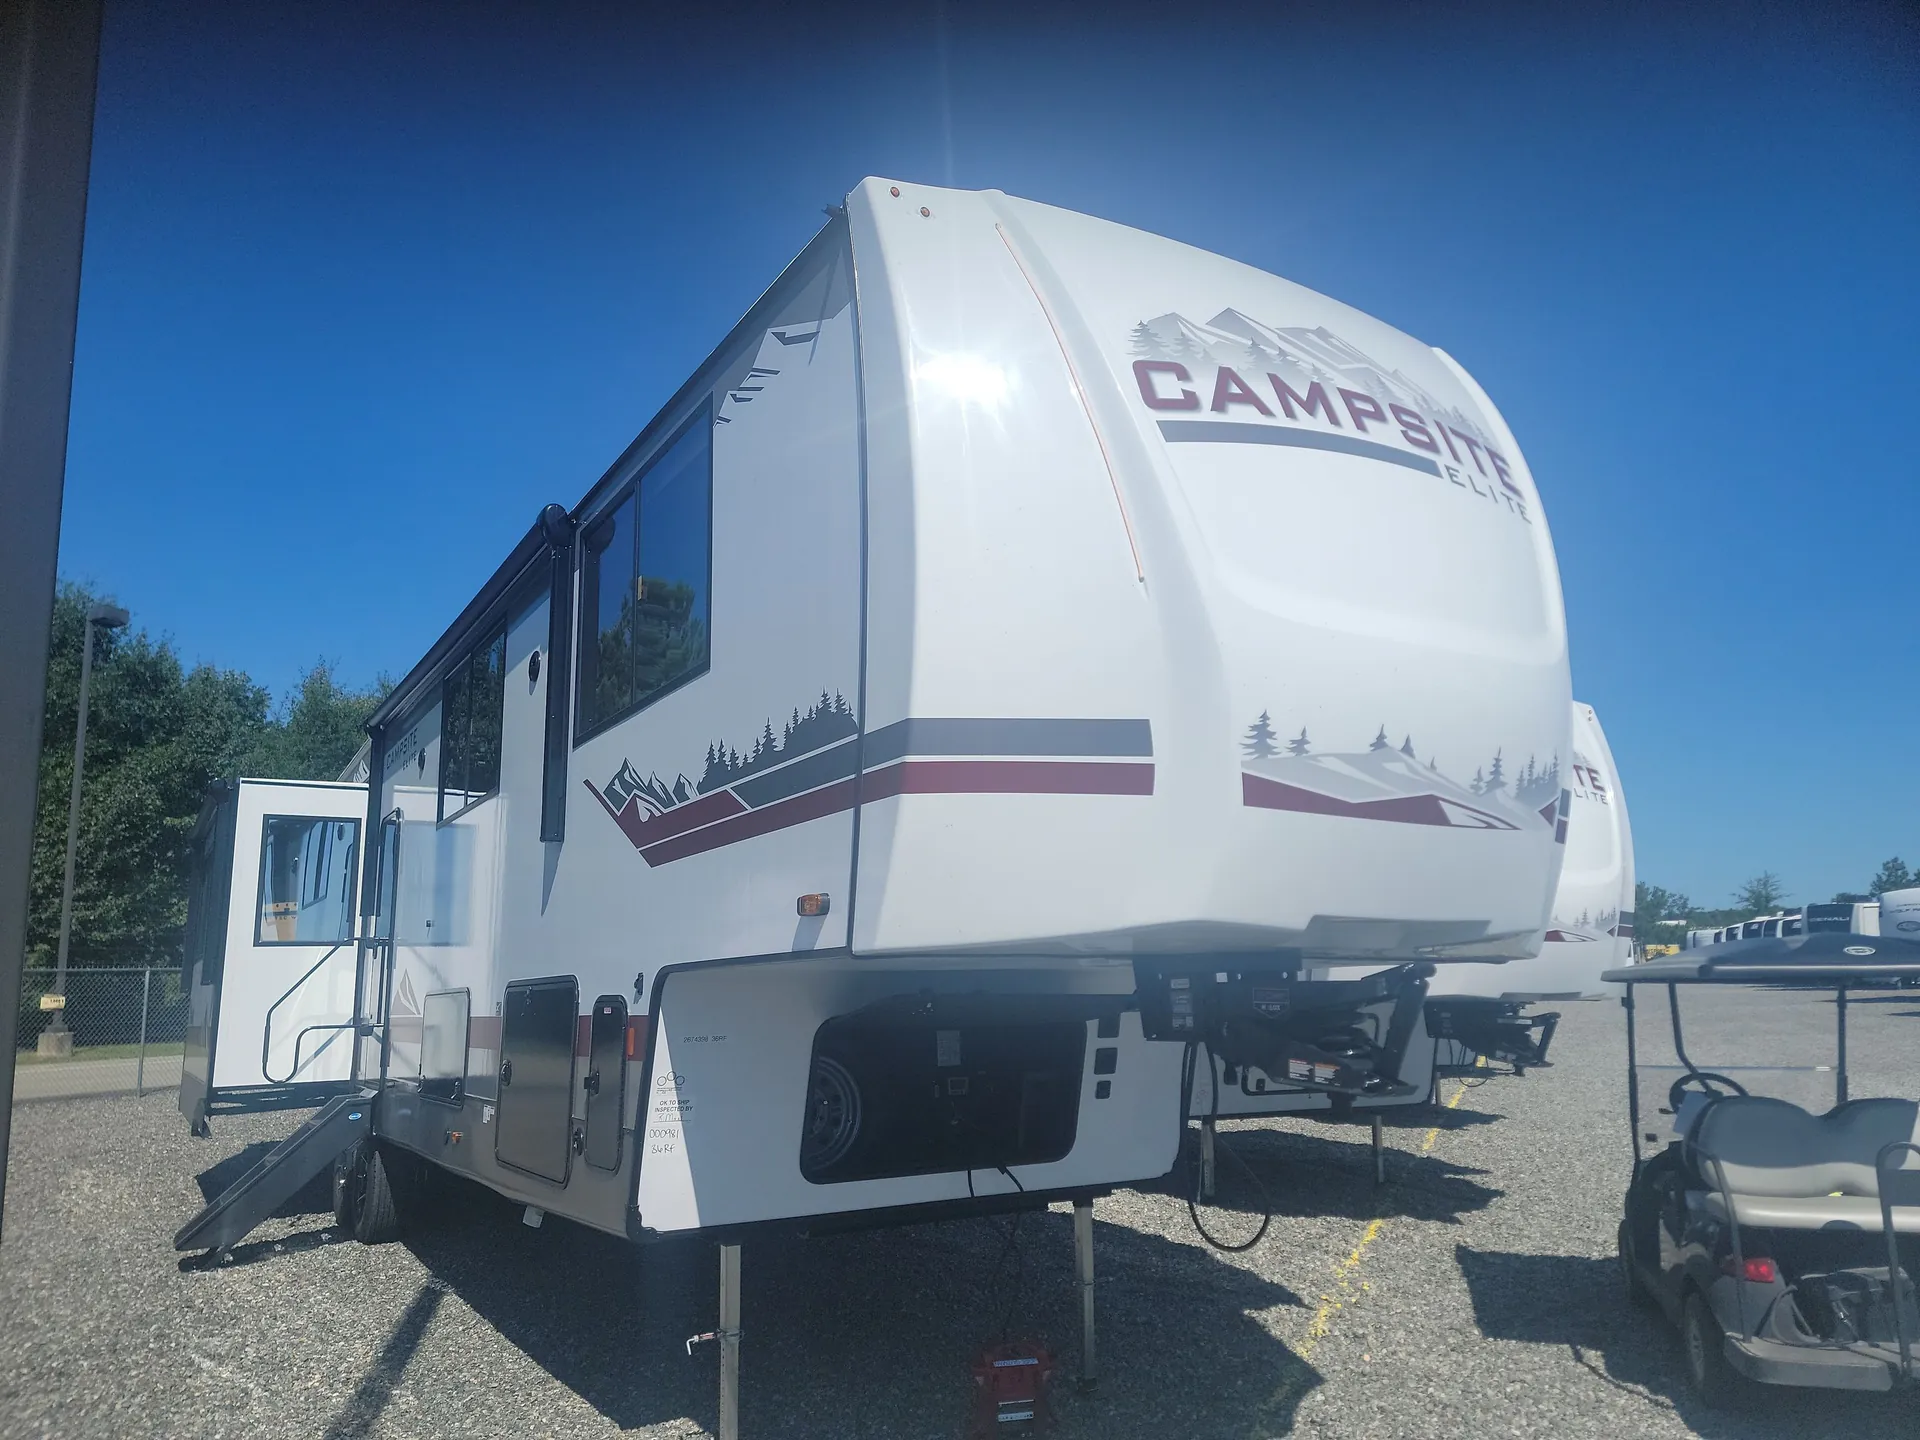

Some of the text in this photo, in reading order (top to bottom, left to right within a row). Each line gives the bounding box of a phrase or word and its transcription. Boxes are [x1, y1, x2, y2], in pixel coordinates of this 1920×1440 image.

[1132, 360, 1525, 499] CAMPSITE
[1443, 463, 1532, 524] ELITE
[386, 727, 418, 770] CAMPSITE
